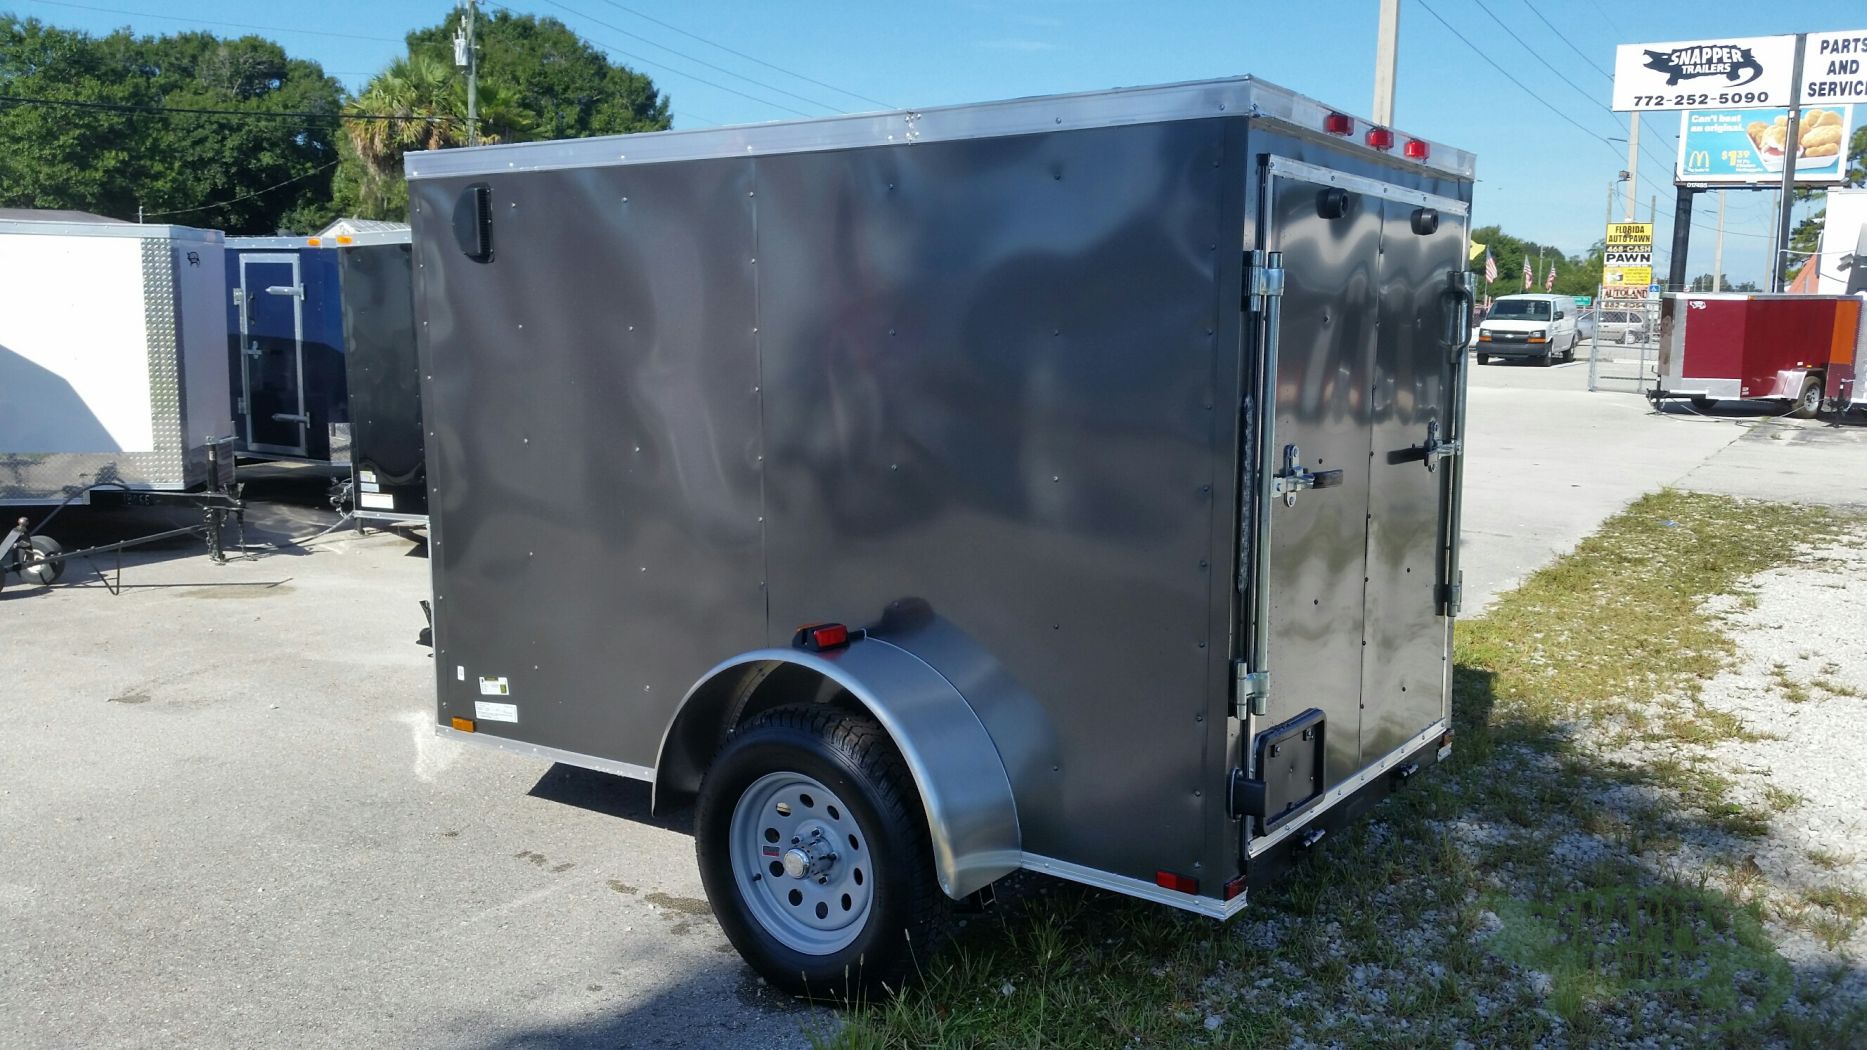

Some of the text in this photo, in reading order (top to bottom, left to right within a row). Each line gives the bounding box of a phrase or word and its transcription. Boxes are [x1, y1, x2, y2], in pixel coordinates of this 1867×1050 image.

[1820, 38, 1867, 55] PARTS
[1668, 48, 1744, 66] SNAPPER
[1681, 64, 1731, 75] TRAILERS
[1826, 59, 1860, 76] AND
[1807, 80, 1867, 98] SERVIC
[1634, 91, 1769, 107] 772-252-5090
[1615, 225, 1645, 234] FLORIDA
[1608, 234, 1651, 243] AUTO PAWN
[1606, 253, 1651, 263] PAWN
[1604, 289, 1648, 299] AUTOLAND
